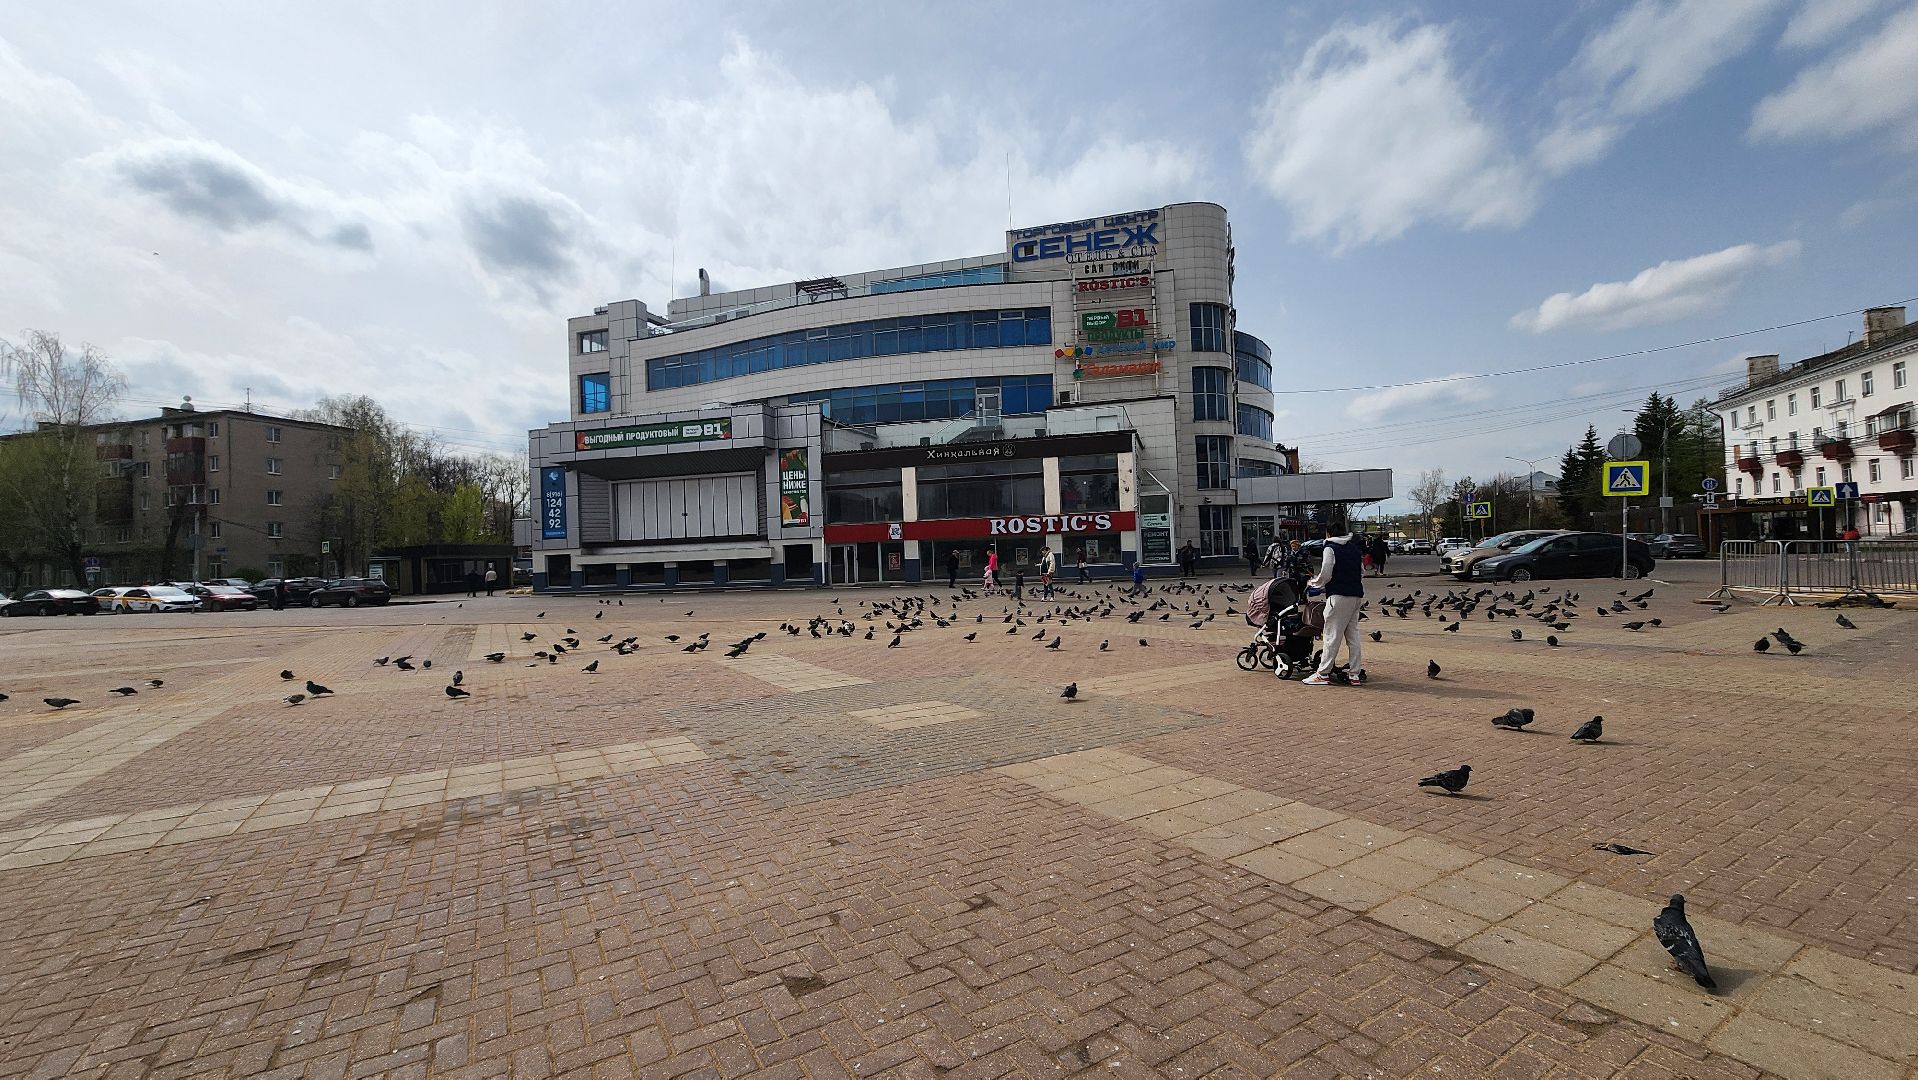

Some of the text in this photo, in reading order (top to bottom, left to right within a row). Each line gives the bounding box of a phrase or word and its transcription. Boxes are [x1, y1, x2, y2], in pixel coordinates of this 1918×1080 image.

[1015, 210, 1159, 240] ТОРГОВЫЙ ЦЕНТР
[1012, 223, 1159, 263] СЕНЕЖ
[1066, 245, 1158, 264] ОТЕЛЬ & СПА
[1084, 263, 1104, 275] САН
[1077, 277, 1150, 292] ROSTIC'S
[583, 430, 624, 445] ВЫГОДНЫЙ
[626, 426, 680, 441] ПРОДУКТОВЫЙ
[927, 447, 1000, 459] Хинкальная
[782, 470, 806, 482] ЦЕНЫ
[783, 480, 807, 490] НИЖЕ
[547, 498, 562, 508] 124
[549, 508, 561, 518] 42
[549, 518, 561, 529] 92
[990, 514, 1112, 535] ROSTIC'S
